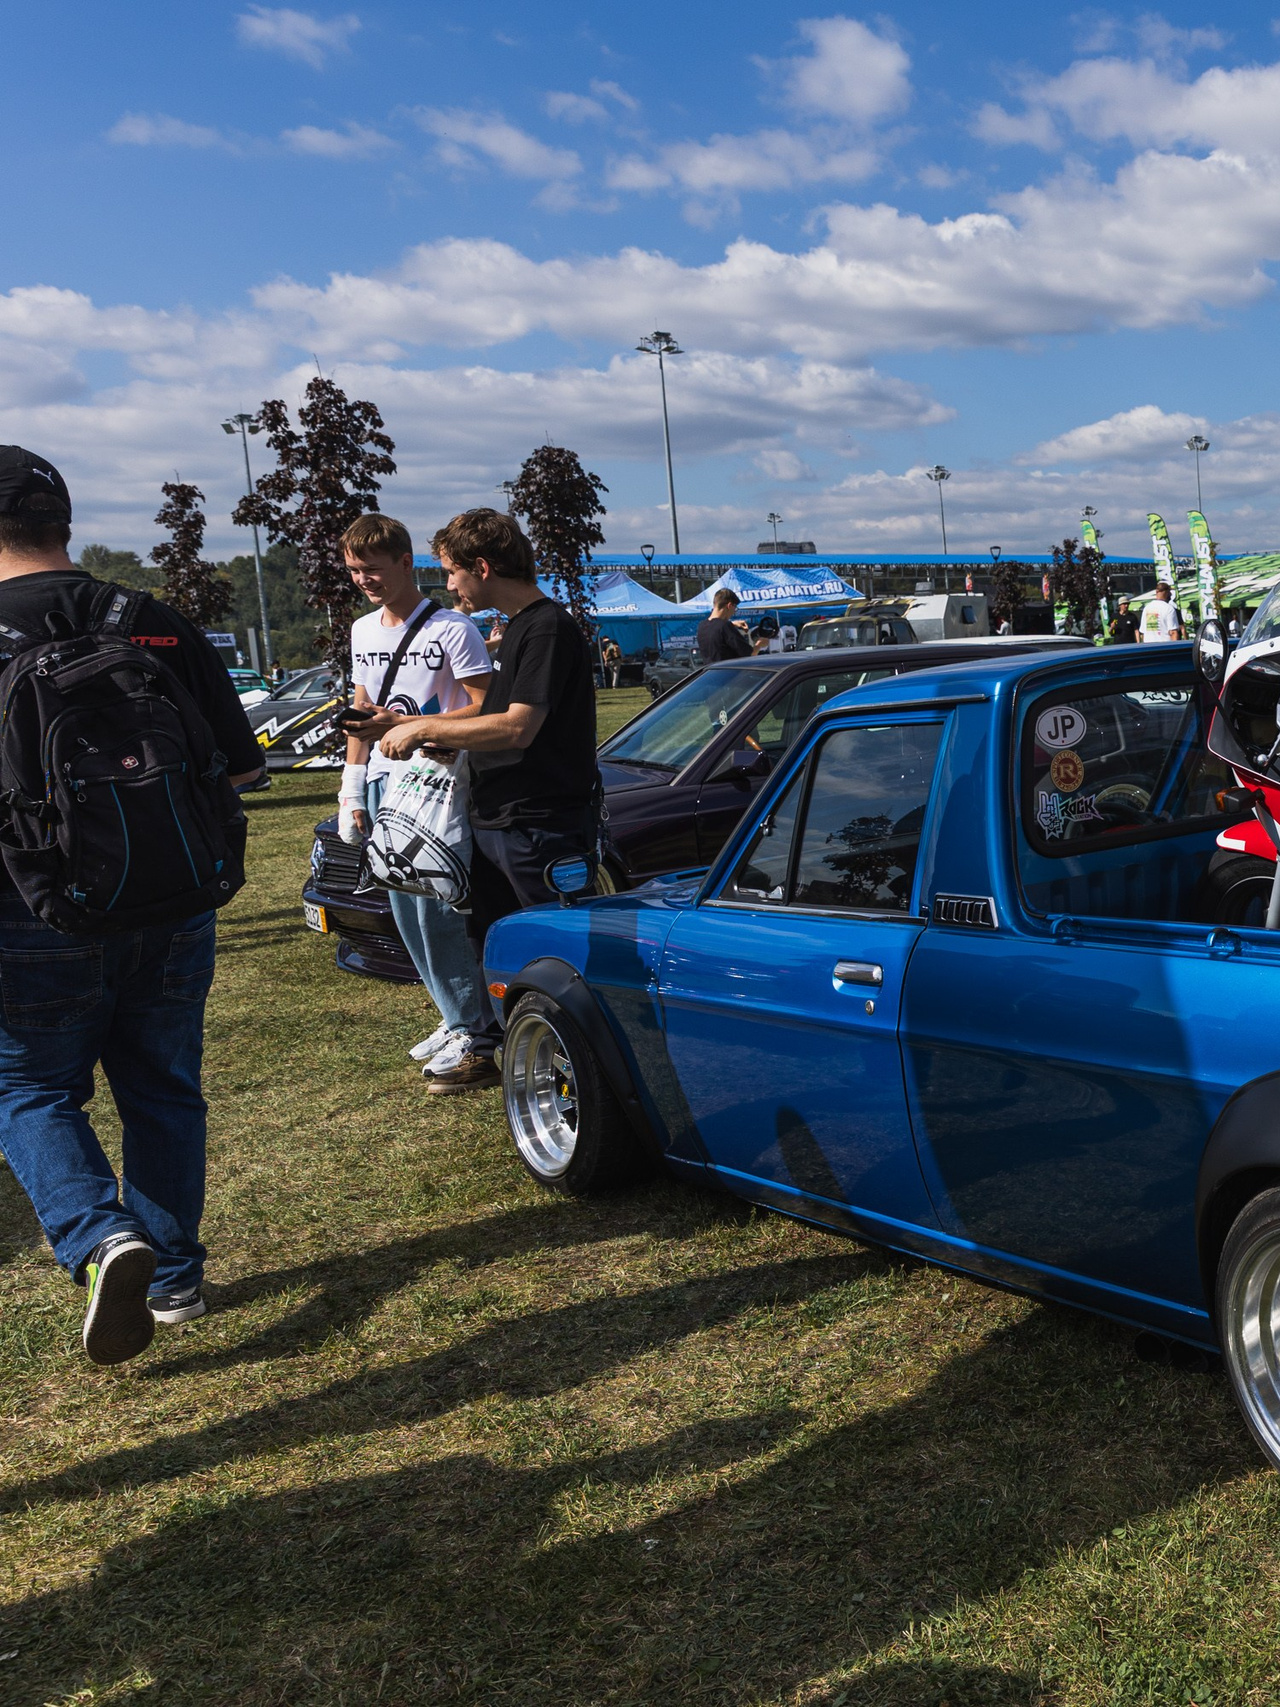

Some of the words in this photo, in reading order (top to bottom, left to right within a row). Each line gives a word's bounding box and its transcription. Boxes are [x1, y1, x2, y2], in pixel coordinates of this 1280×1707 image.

[1193, 533, 1218, 620] EXHAUST
[735, 581, 845, 602] AUTOFANATIC.RU
[355, 651, 421, 668] PATROT
[1047, 714, 1075, 741] JP
[1059, 763, 1078, 779] R
